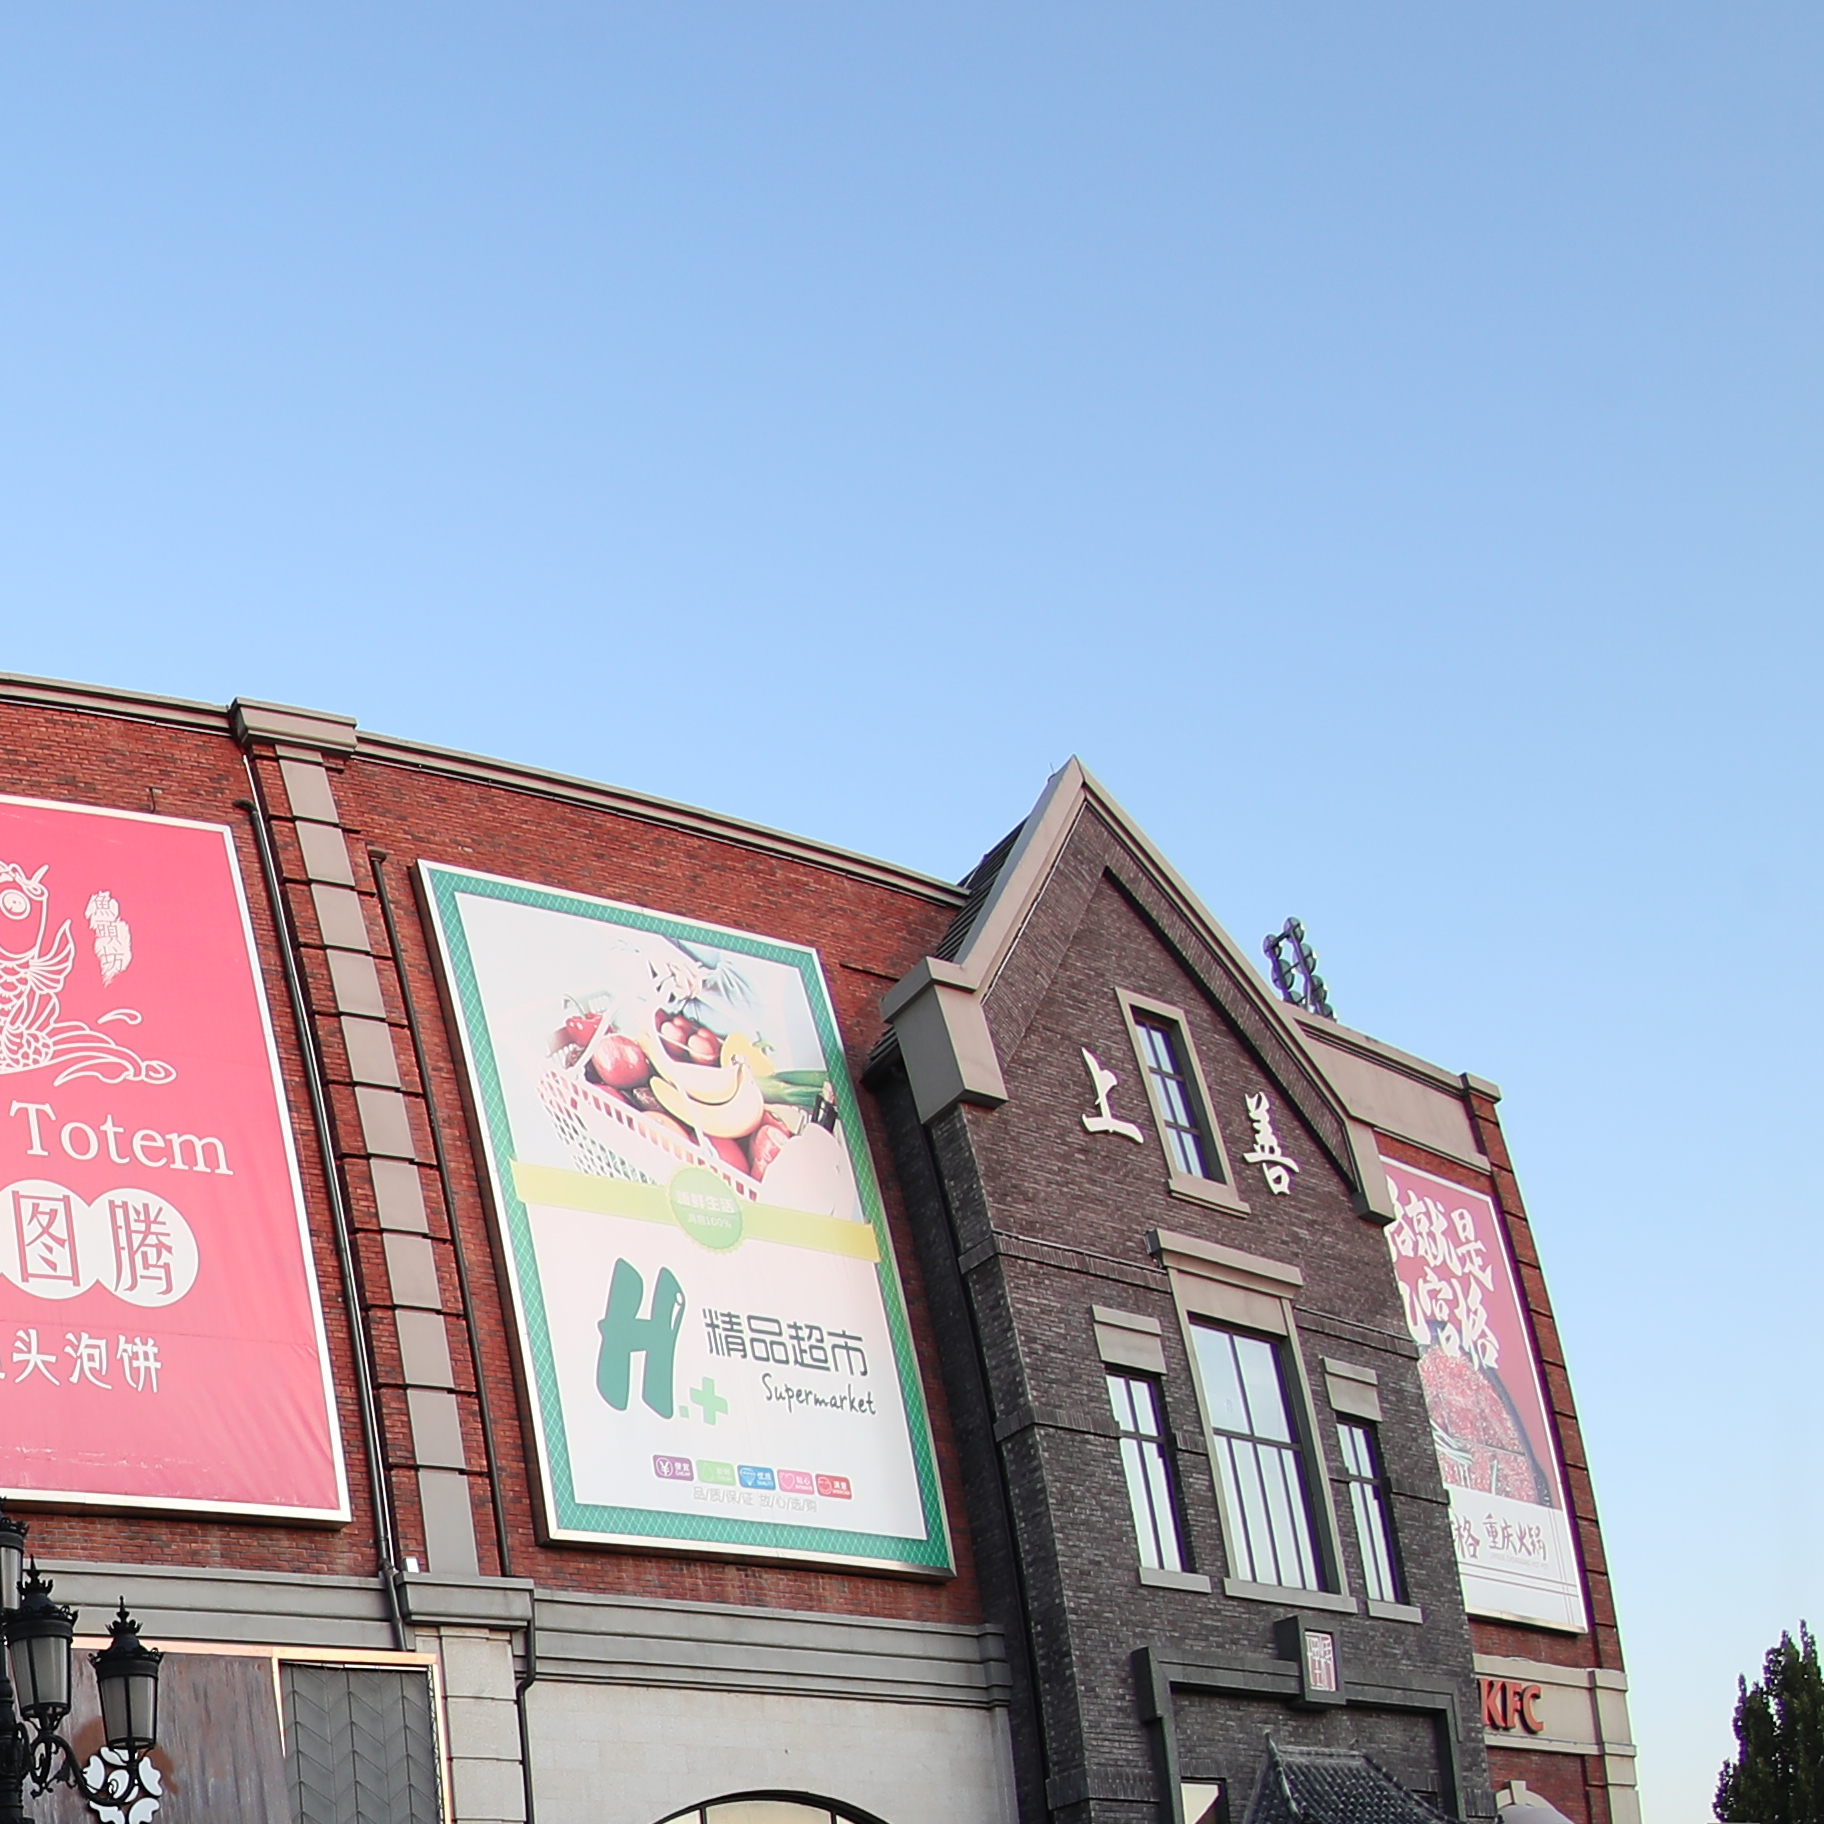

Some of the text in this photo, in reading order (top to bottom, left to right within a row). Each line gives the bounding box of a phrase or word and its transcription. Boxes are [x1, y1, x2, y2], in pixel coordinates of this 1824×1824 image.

[9, 1101, 234, 1176] Totem
[701, 1307, 869, 1377] 精品超市
[761, 1371, 877, 1416] Supermarket
[1478, 1678, 1545, 1735] KFC
